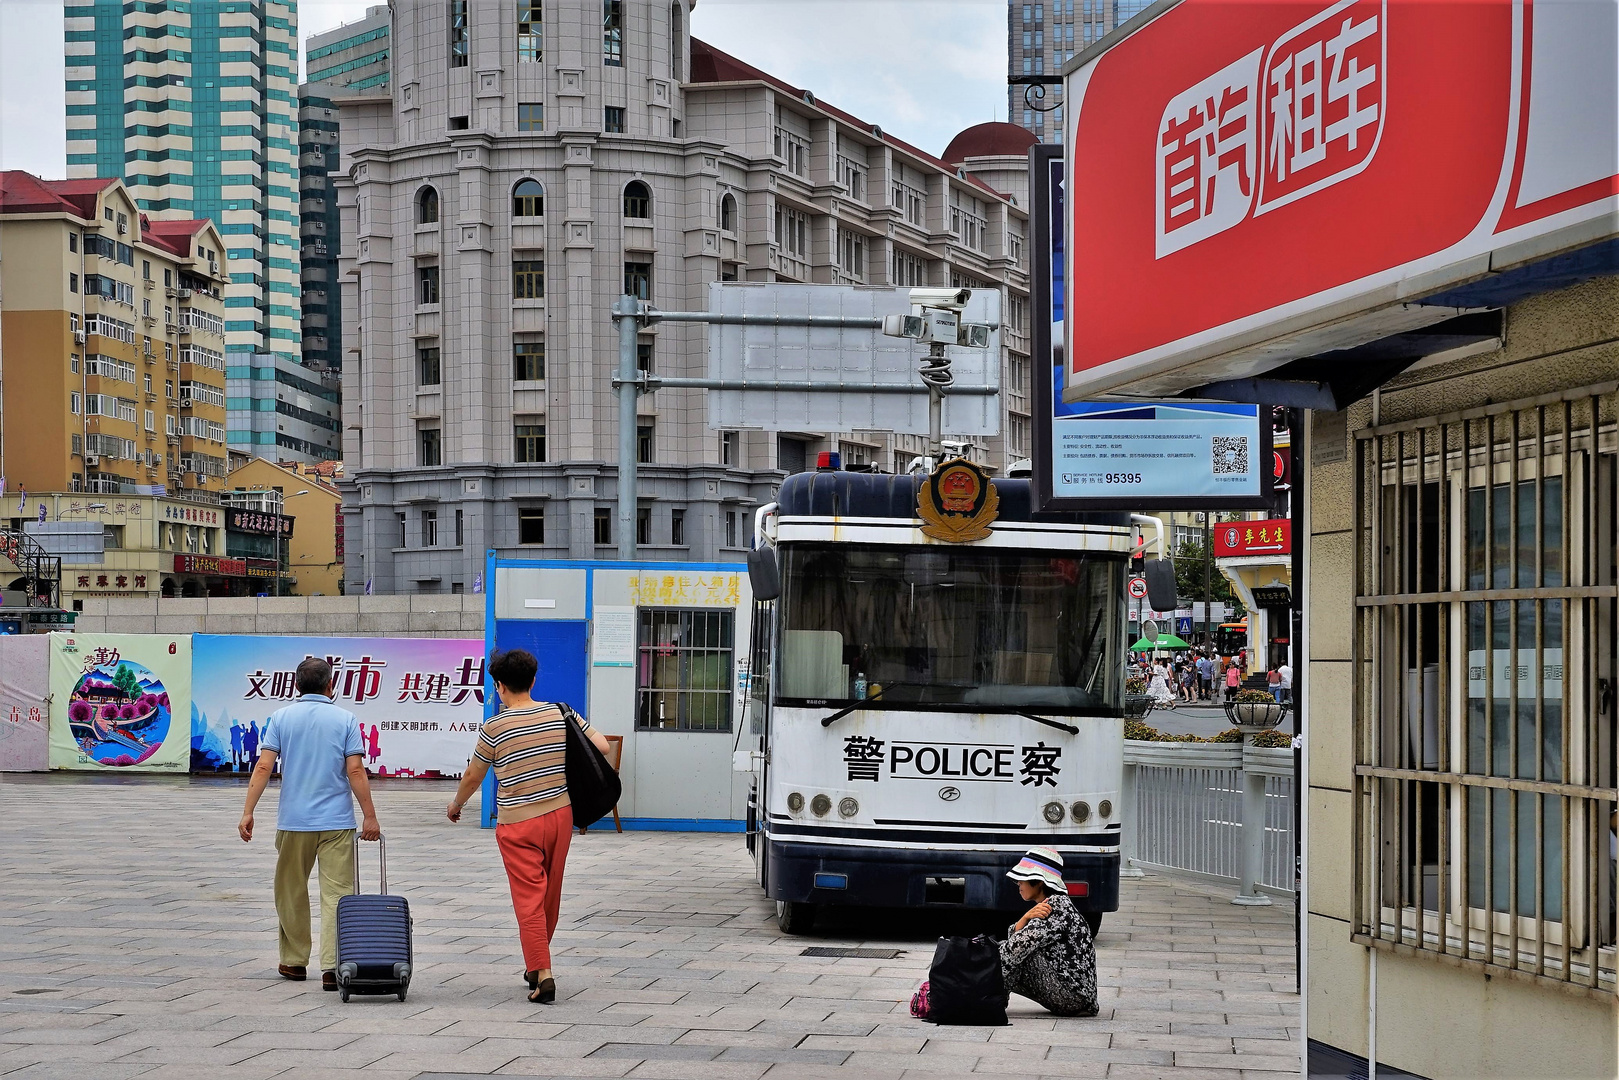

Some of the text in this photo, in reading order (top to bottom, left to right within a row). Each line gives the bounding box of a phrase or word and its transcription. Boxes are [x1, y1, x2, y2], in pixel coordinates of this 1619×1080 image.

[1159, 14, 1382, 245] 首汽租车
[1105, 473, 1142, 484] 95395
[1244, 527, 1284, 544] 李先生
[9, 706, 41, 722] 青岛
[843, 735, 1062, 787] 警 POLICE 察
